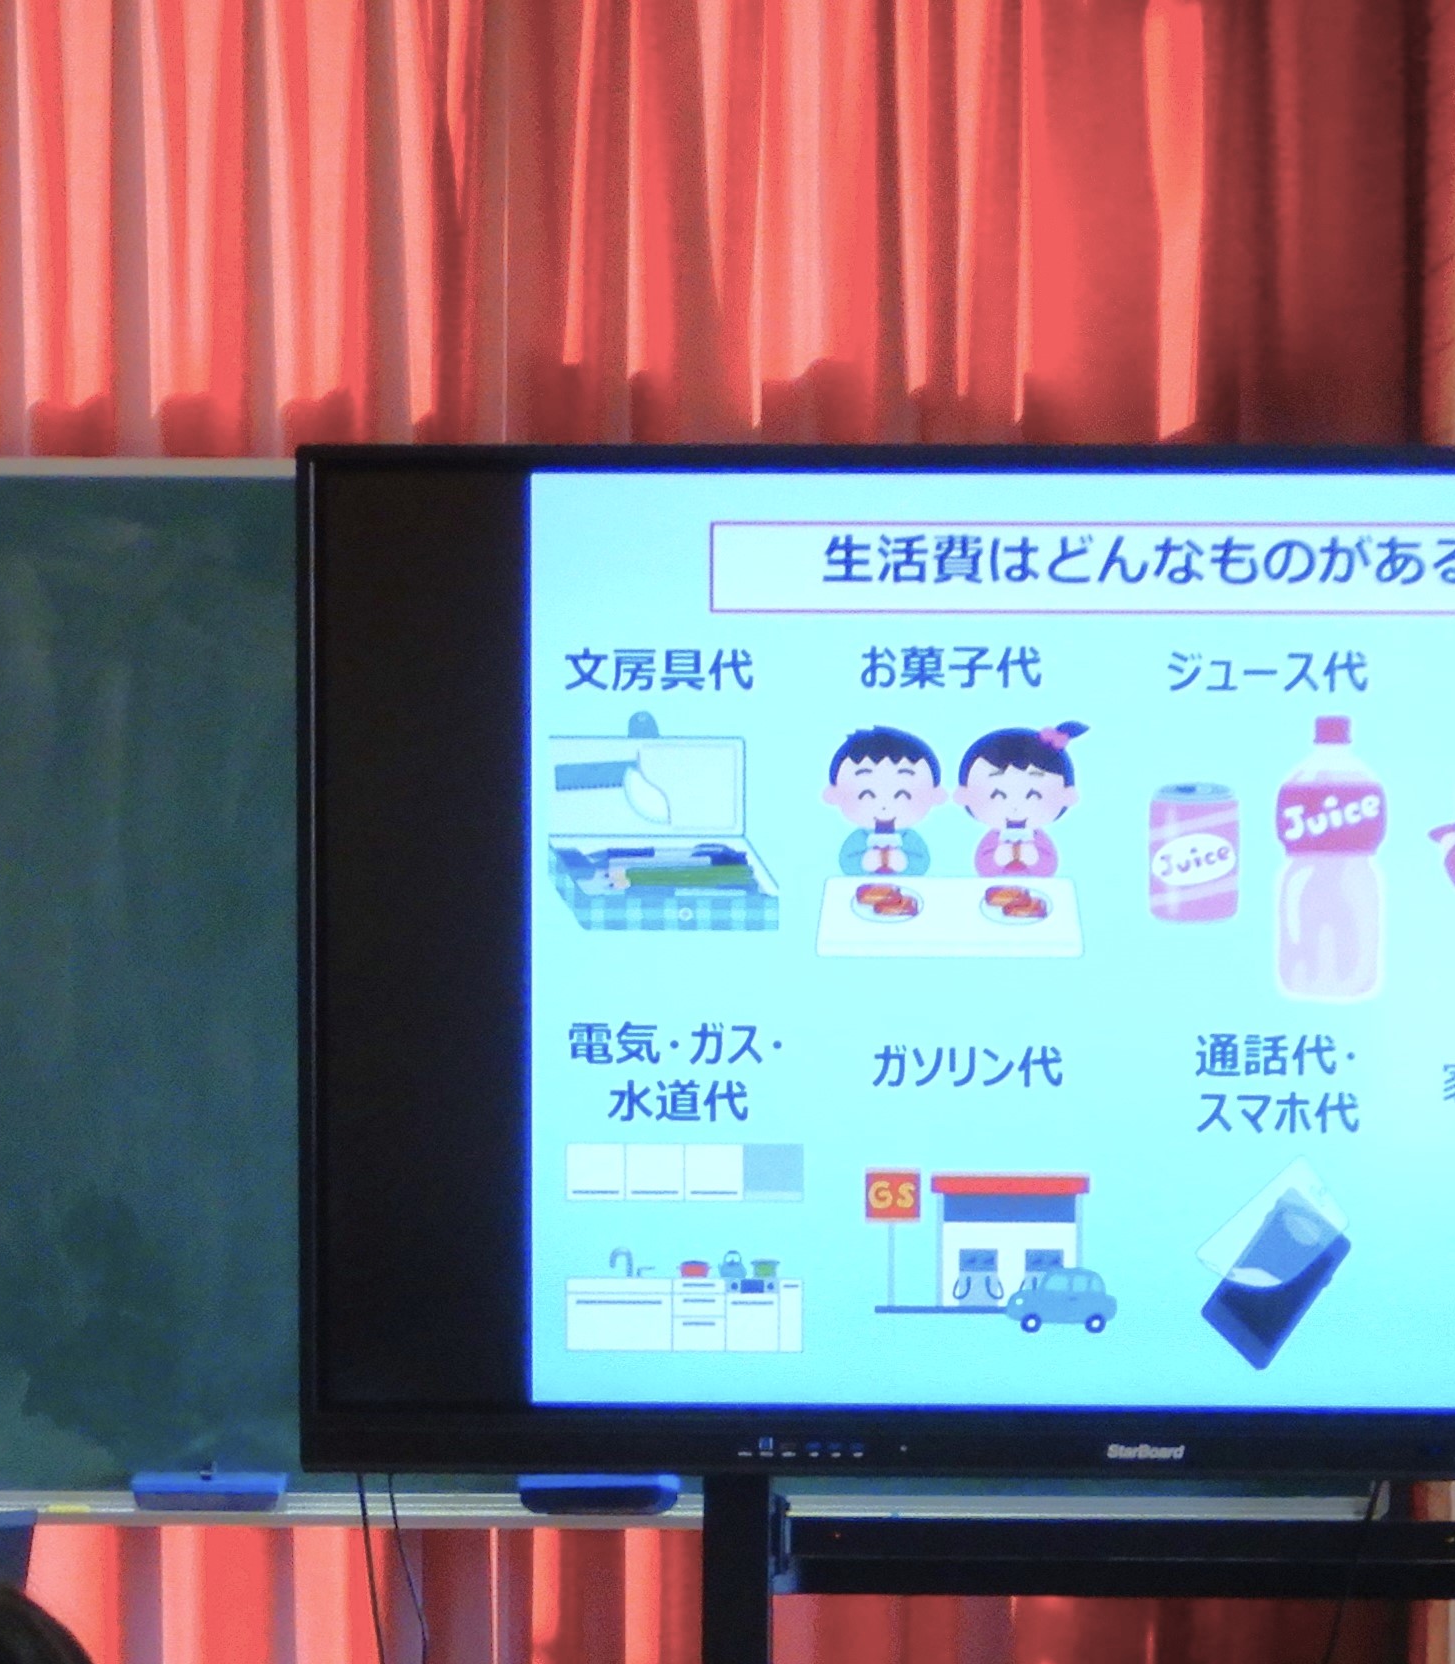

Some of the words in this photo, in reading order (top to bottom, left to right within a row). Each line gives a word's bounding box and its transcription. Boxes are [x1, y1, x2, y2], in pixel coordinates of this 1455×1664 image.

[564, 646, 754, 692] 文房具代
[860, 645, 1042, 690] お菓子代
[1167, 649, 1369, 694] ジュース代
[1284, 795, 1381, 840] Juice
[1160, 846, 1230, 877] Juice
[872, 1044, 1063, 1089] ガソリン代
[607, 1079, 749, 1122] 水道代
[1196, 1091, 1360, 1134] スマホ代
[868, 1180, 915, 1209] GS
[1106, 1443, 1185, 1459] StarBoard
